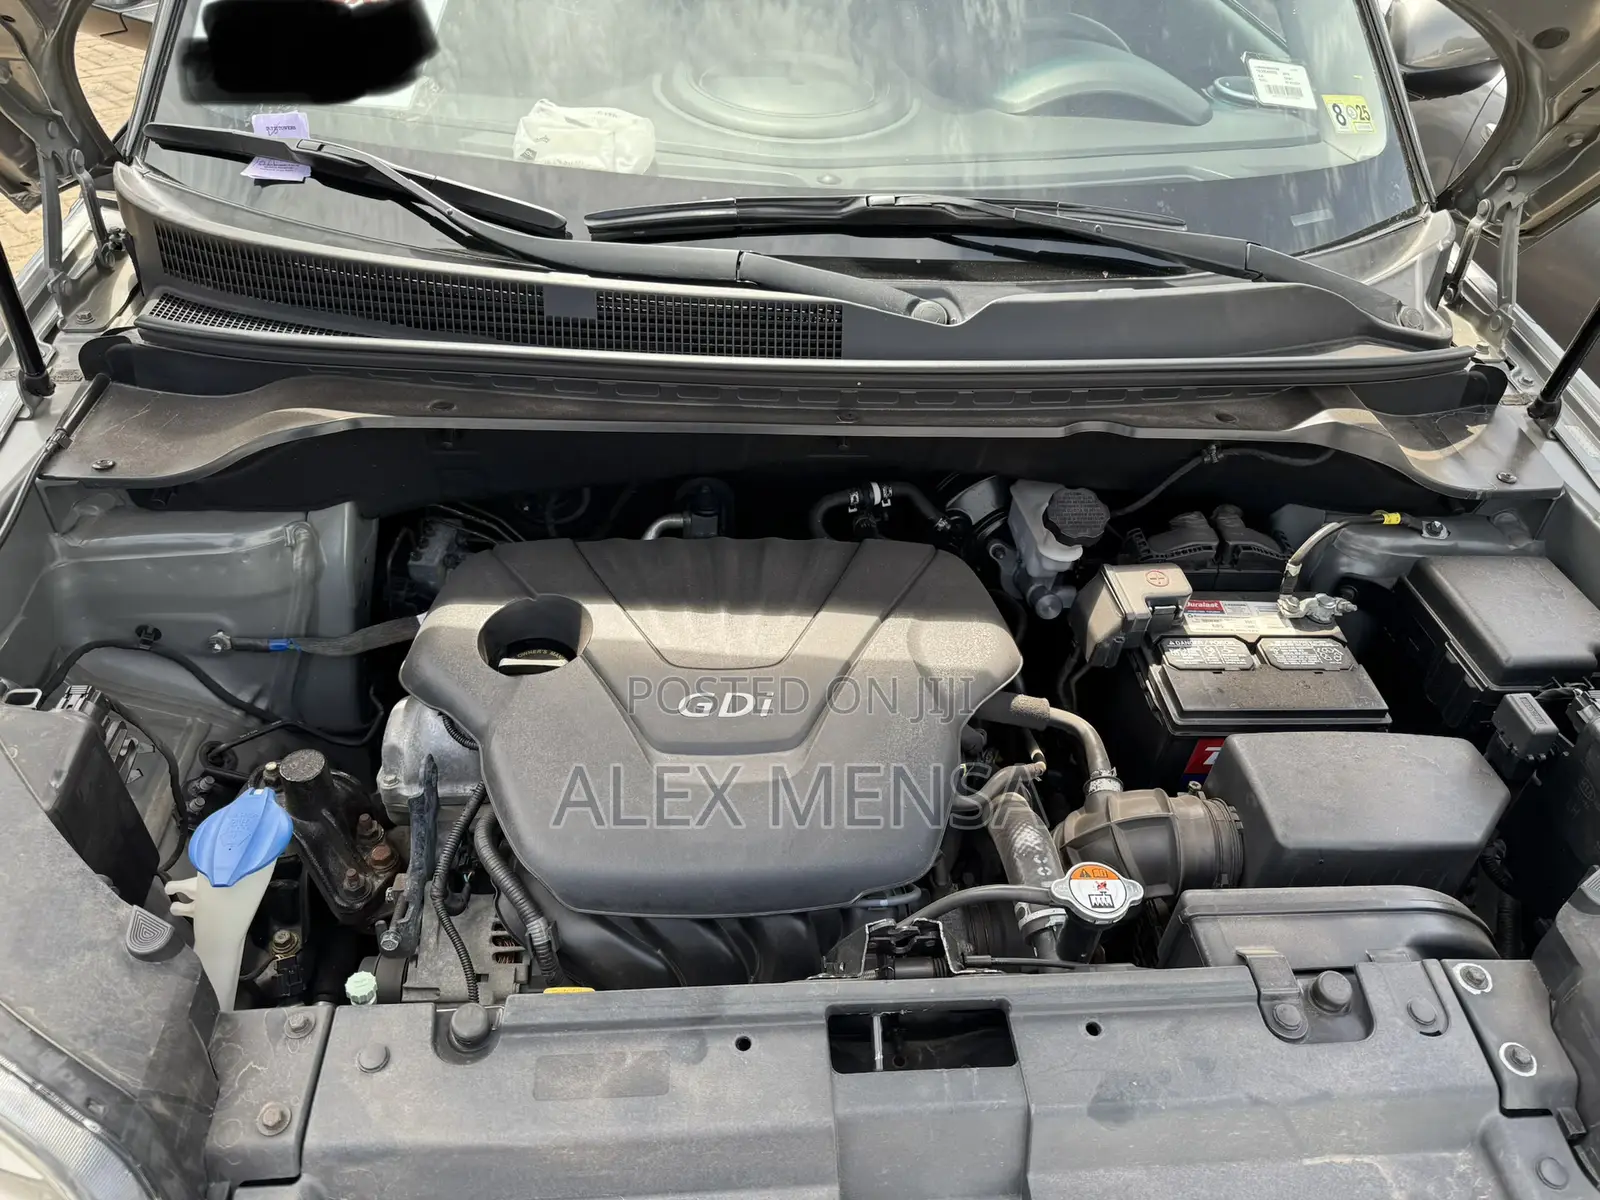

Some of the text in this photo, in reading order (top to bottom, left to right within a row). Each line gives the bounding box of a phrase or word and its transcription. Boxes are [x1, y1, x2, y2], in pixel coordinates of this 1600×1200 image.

[1332, 103, 1370, 126] 8 25
[517, 649, 548, 658] OWNER'S
[678, 691, 774, 718] GDi
